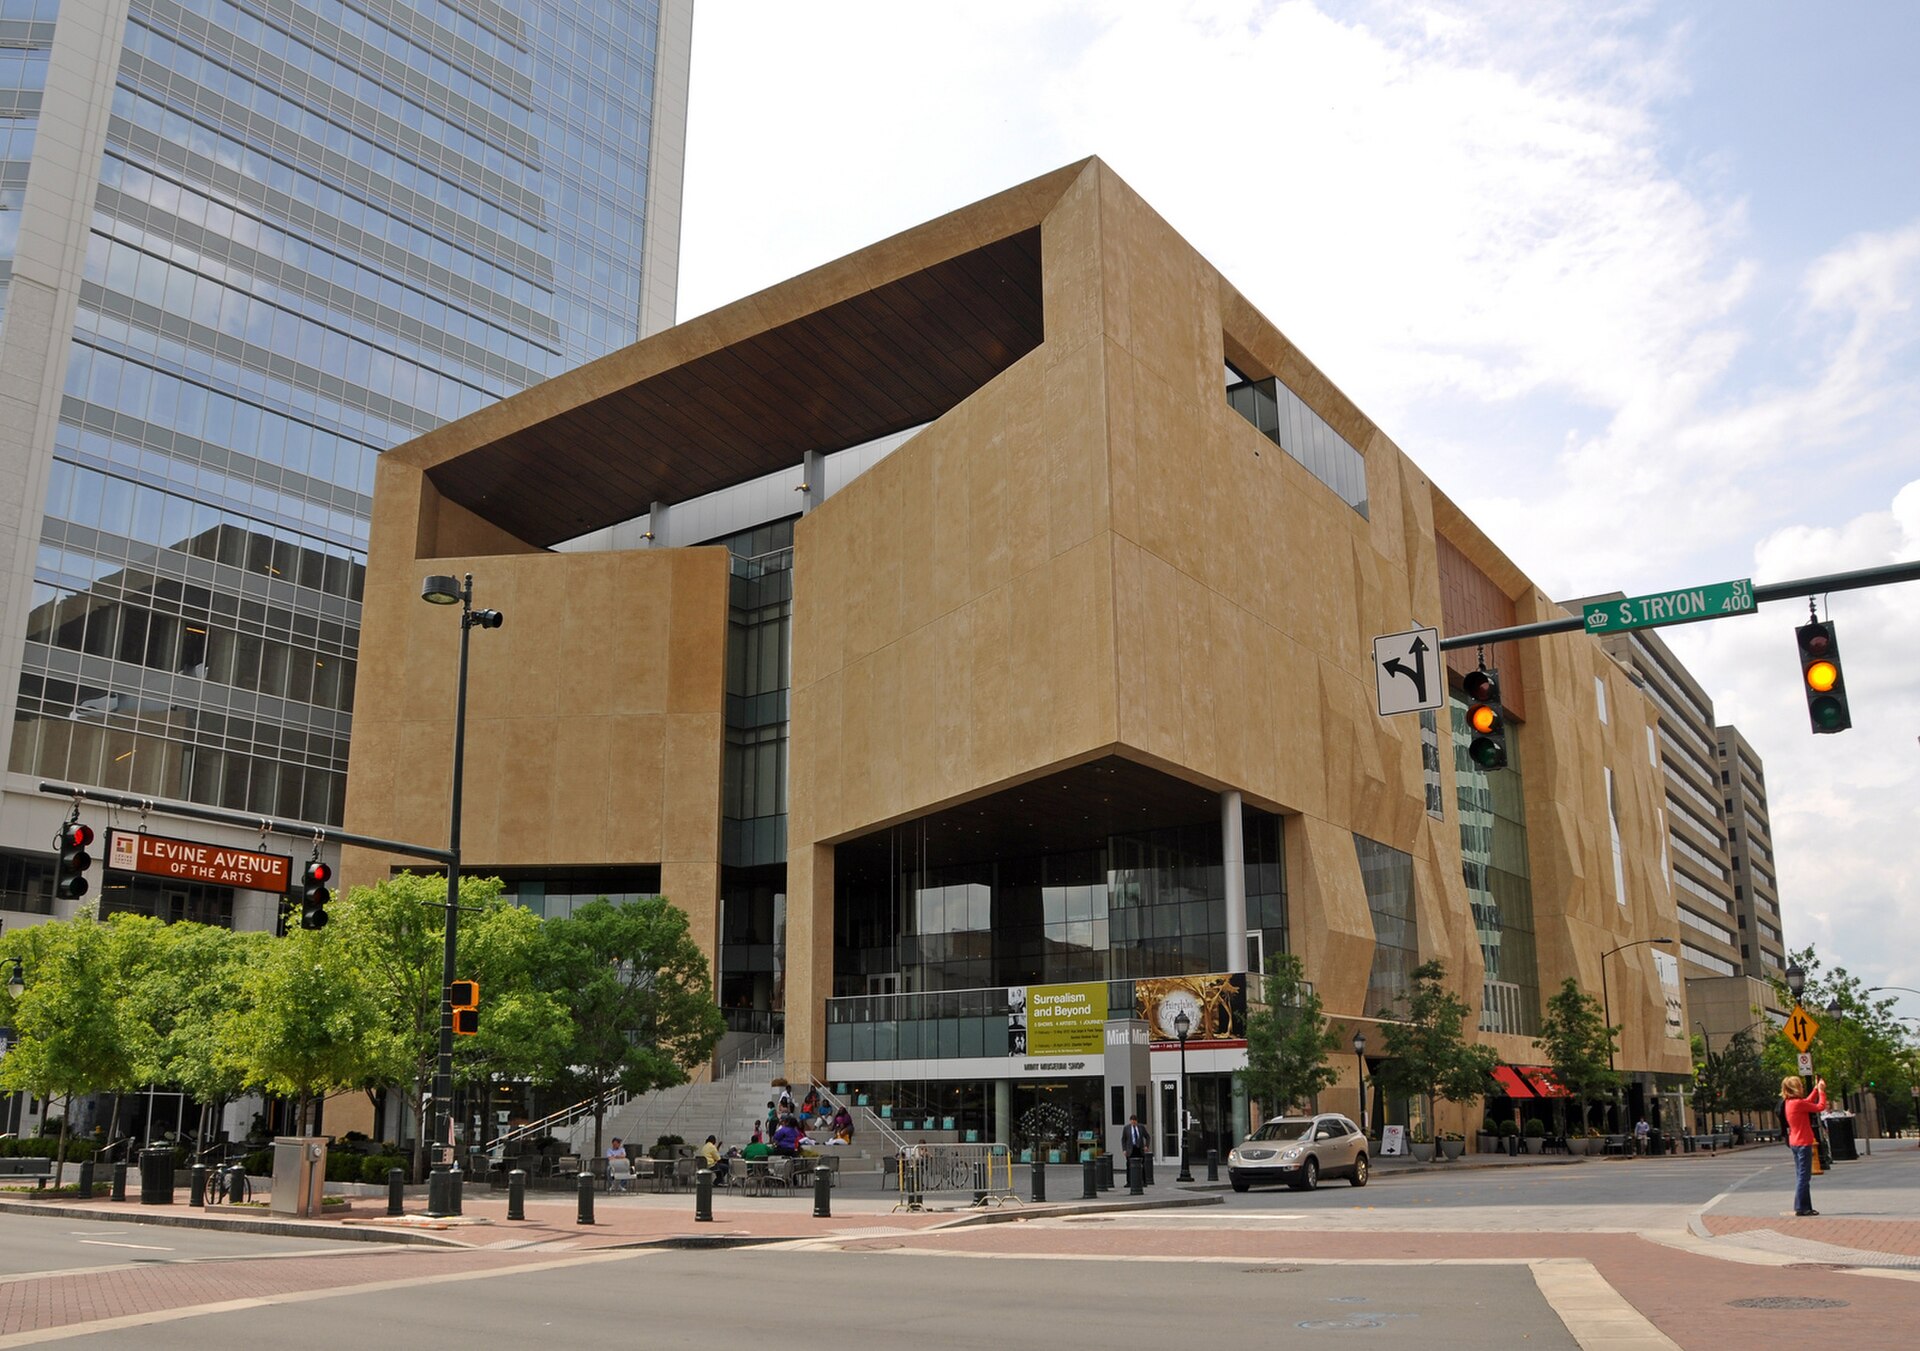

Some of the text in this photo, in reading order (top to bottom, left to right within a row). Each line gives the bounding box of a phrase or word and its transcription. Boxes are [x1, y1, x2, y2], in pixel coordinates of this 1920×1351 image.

[1732, 580, 1749, 595] ST
[1619, 591, 1706, 625] S. TRYON
[1722, 594, 1751, 612] 400
[143, 840, 282, 875] LEVINE AVENUE
[170, 862, 253, 883] OF THE ARTS
[1033, 993, 1086, 1004] Surrealism
[1034, 1004, 1091, 1018] and Beyond
[1107, 1029, 1130, 1046] Mint
[1132, 1028, 1150, 1045] Mint
[1040, 1062, 1067, 1071] MUSEUM
[1068, 1062, 1085, 1070] SHOP
